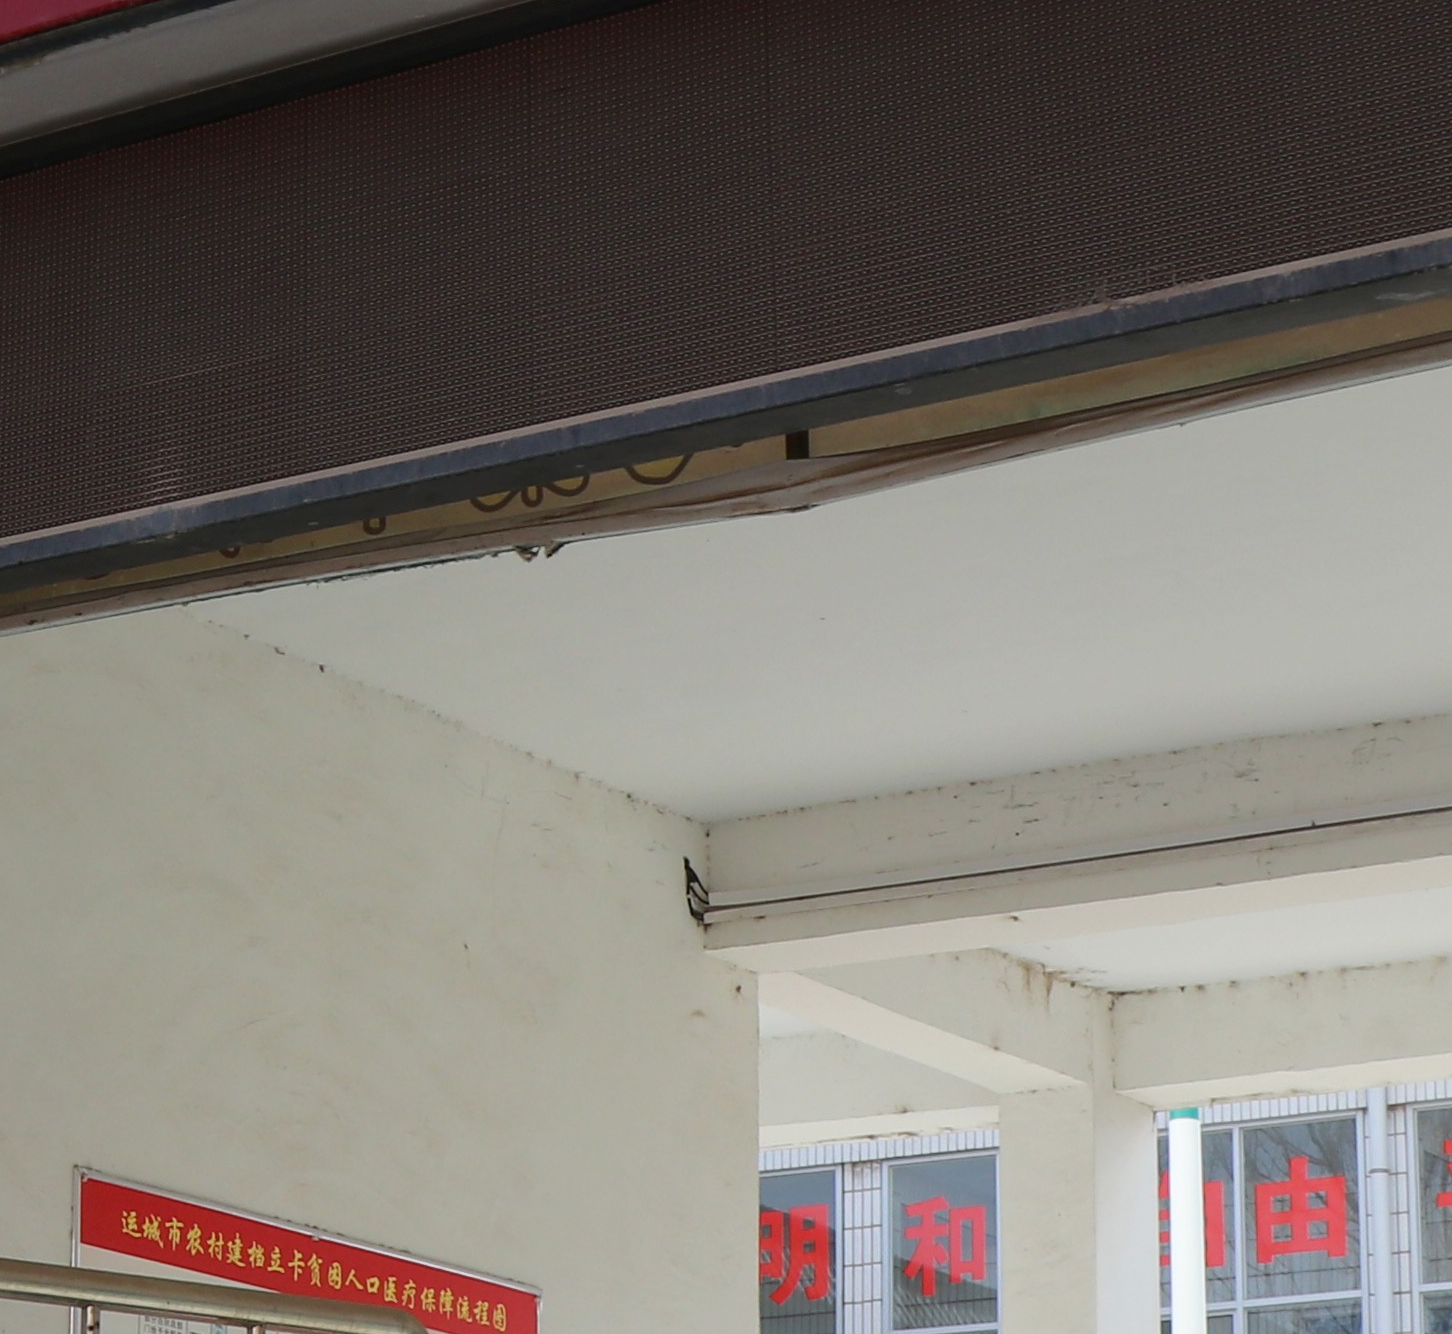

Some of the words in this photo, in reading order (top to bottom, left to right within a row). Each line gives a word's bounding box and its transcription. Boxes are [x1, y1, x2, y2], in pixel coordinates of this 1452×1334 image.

[121, 1210, 508, 1333] 运城市农村建档立卡贫困人口医疗保障流程图
[904, 1196, 988, 1297] 和
